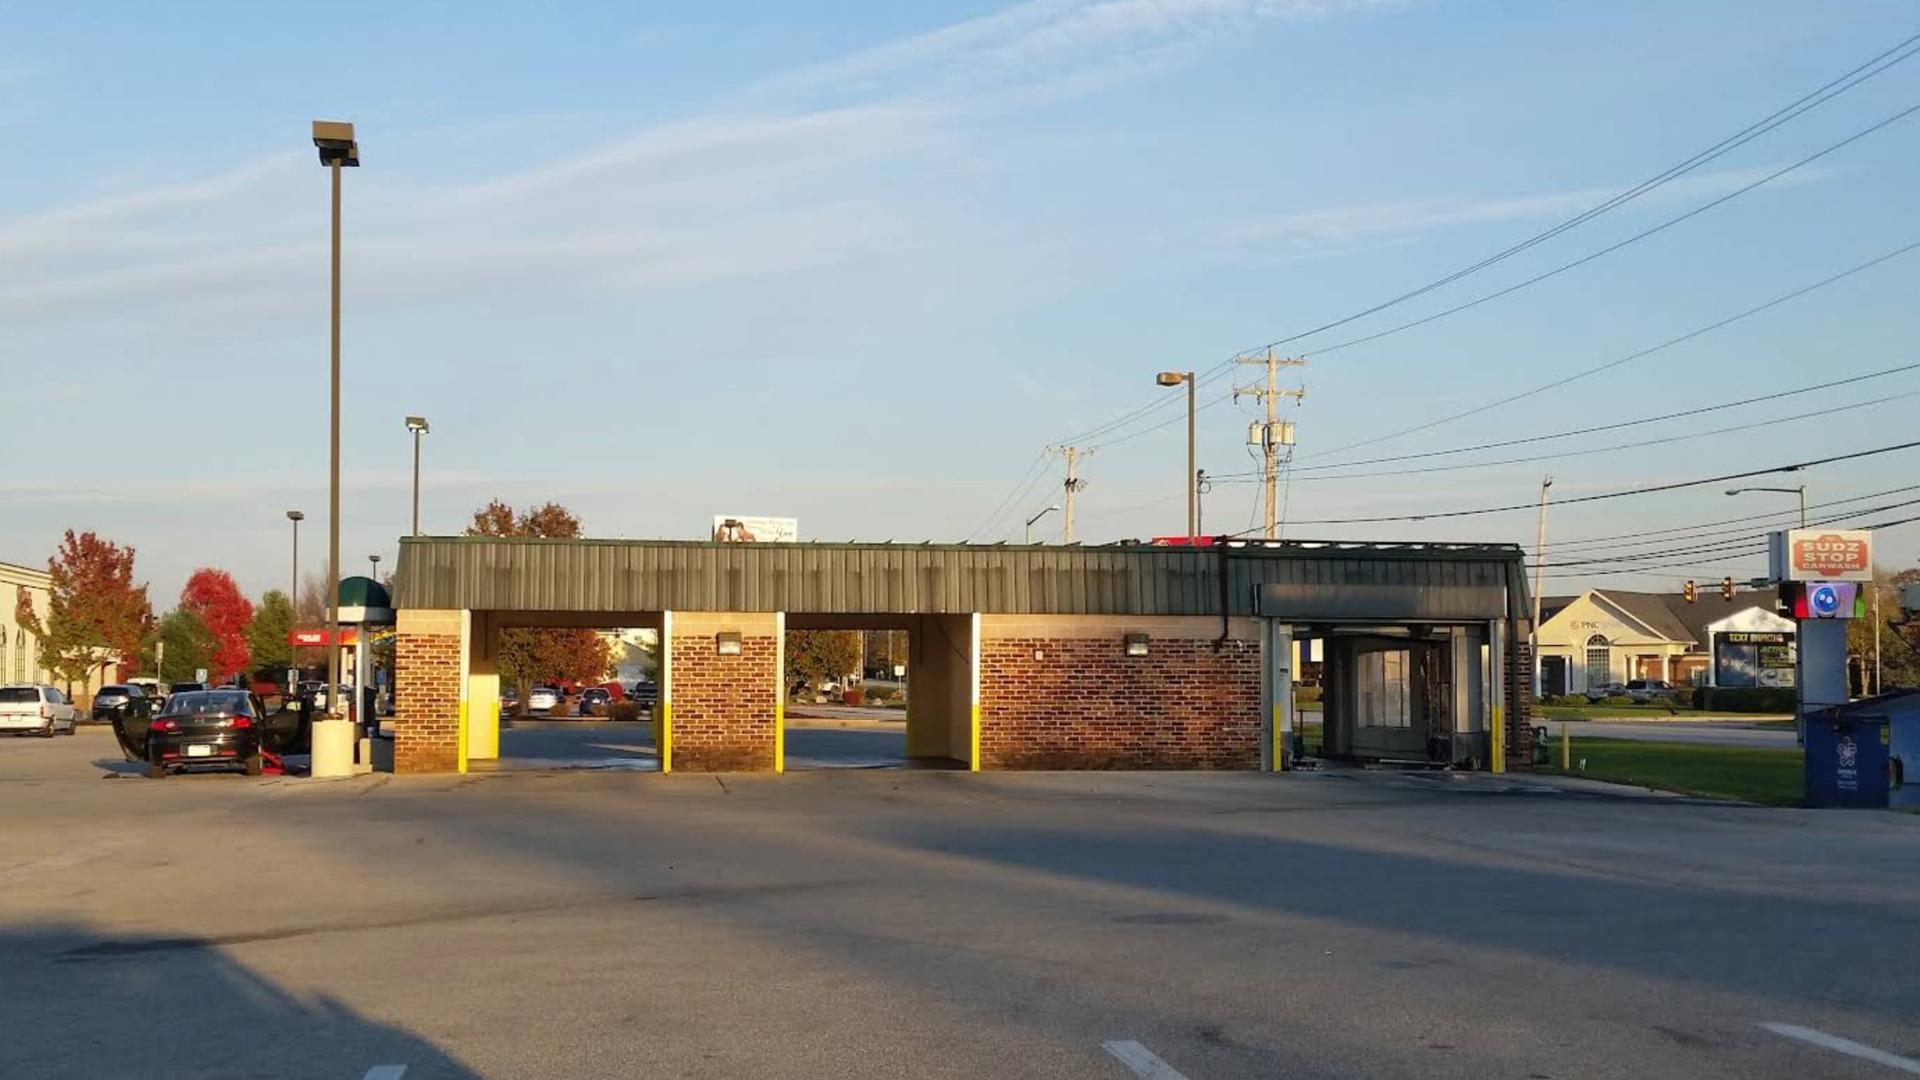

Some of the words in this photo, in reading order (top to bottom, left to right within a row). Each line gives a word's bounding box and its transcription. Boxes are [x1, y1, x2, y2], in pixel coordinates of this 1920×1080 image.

[1803, 543, 1859, 551] SUDZ
[1804, 553, 1859, 561] STOP
[1581, 621, 1600, 629] PNC
